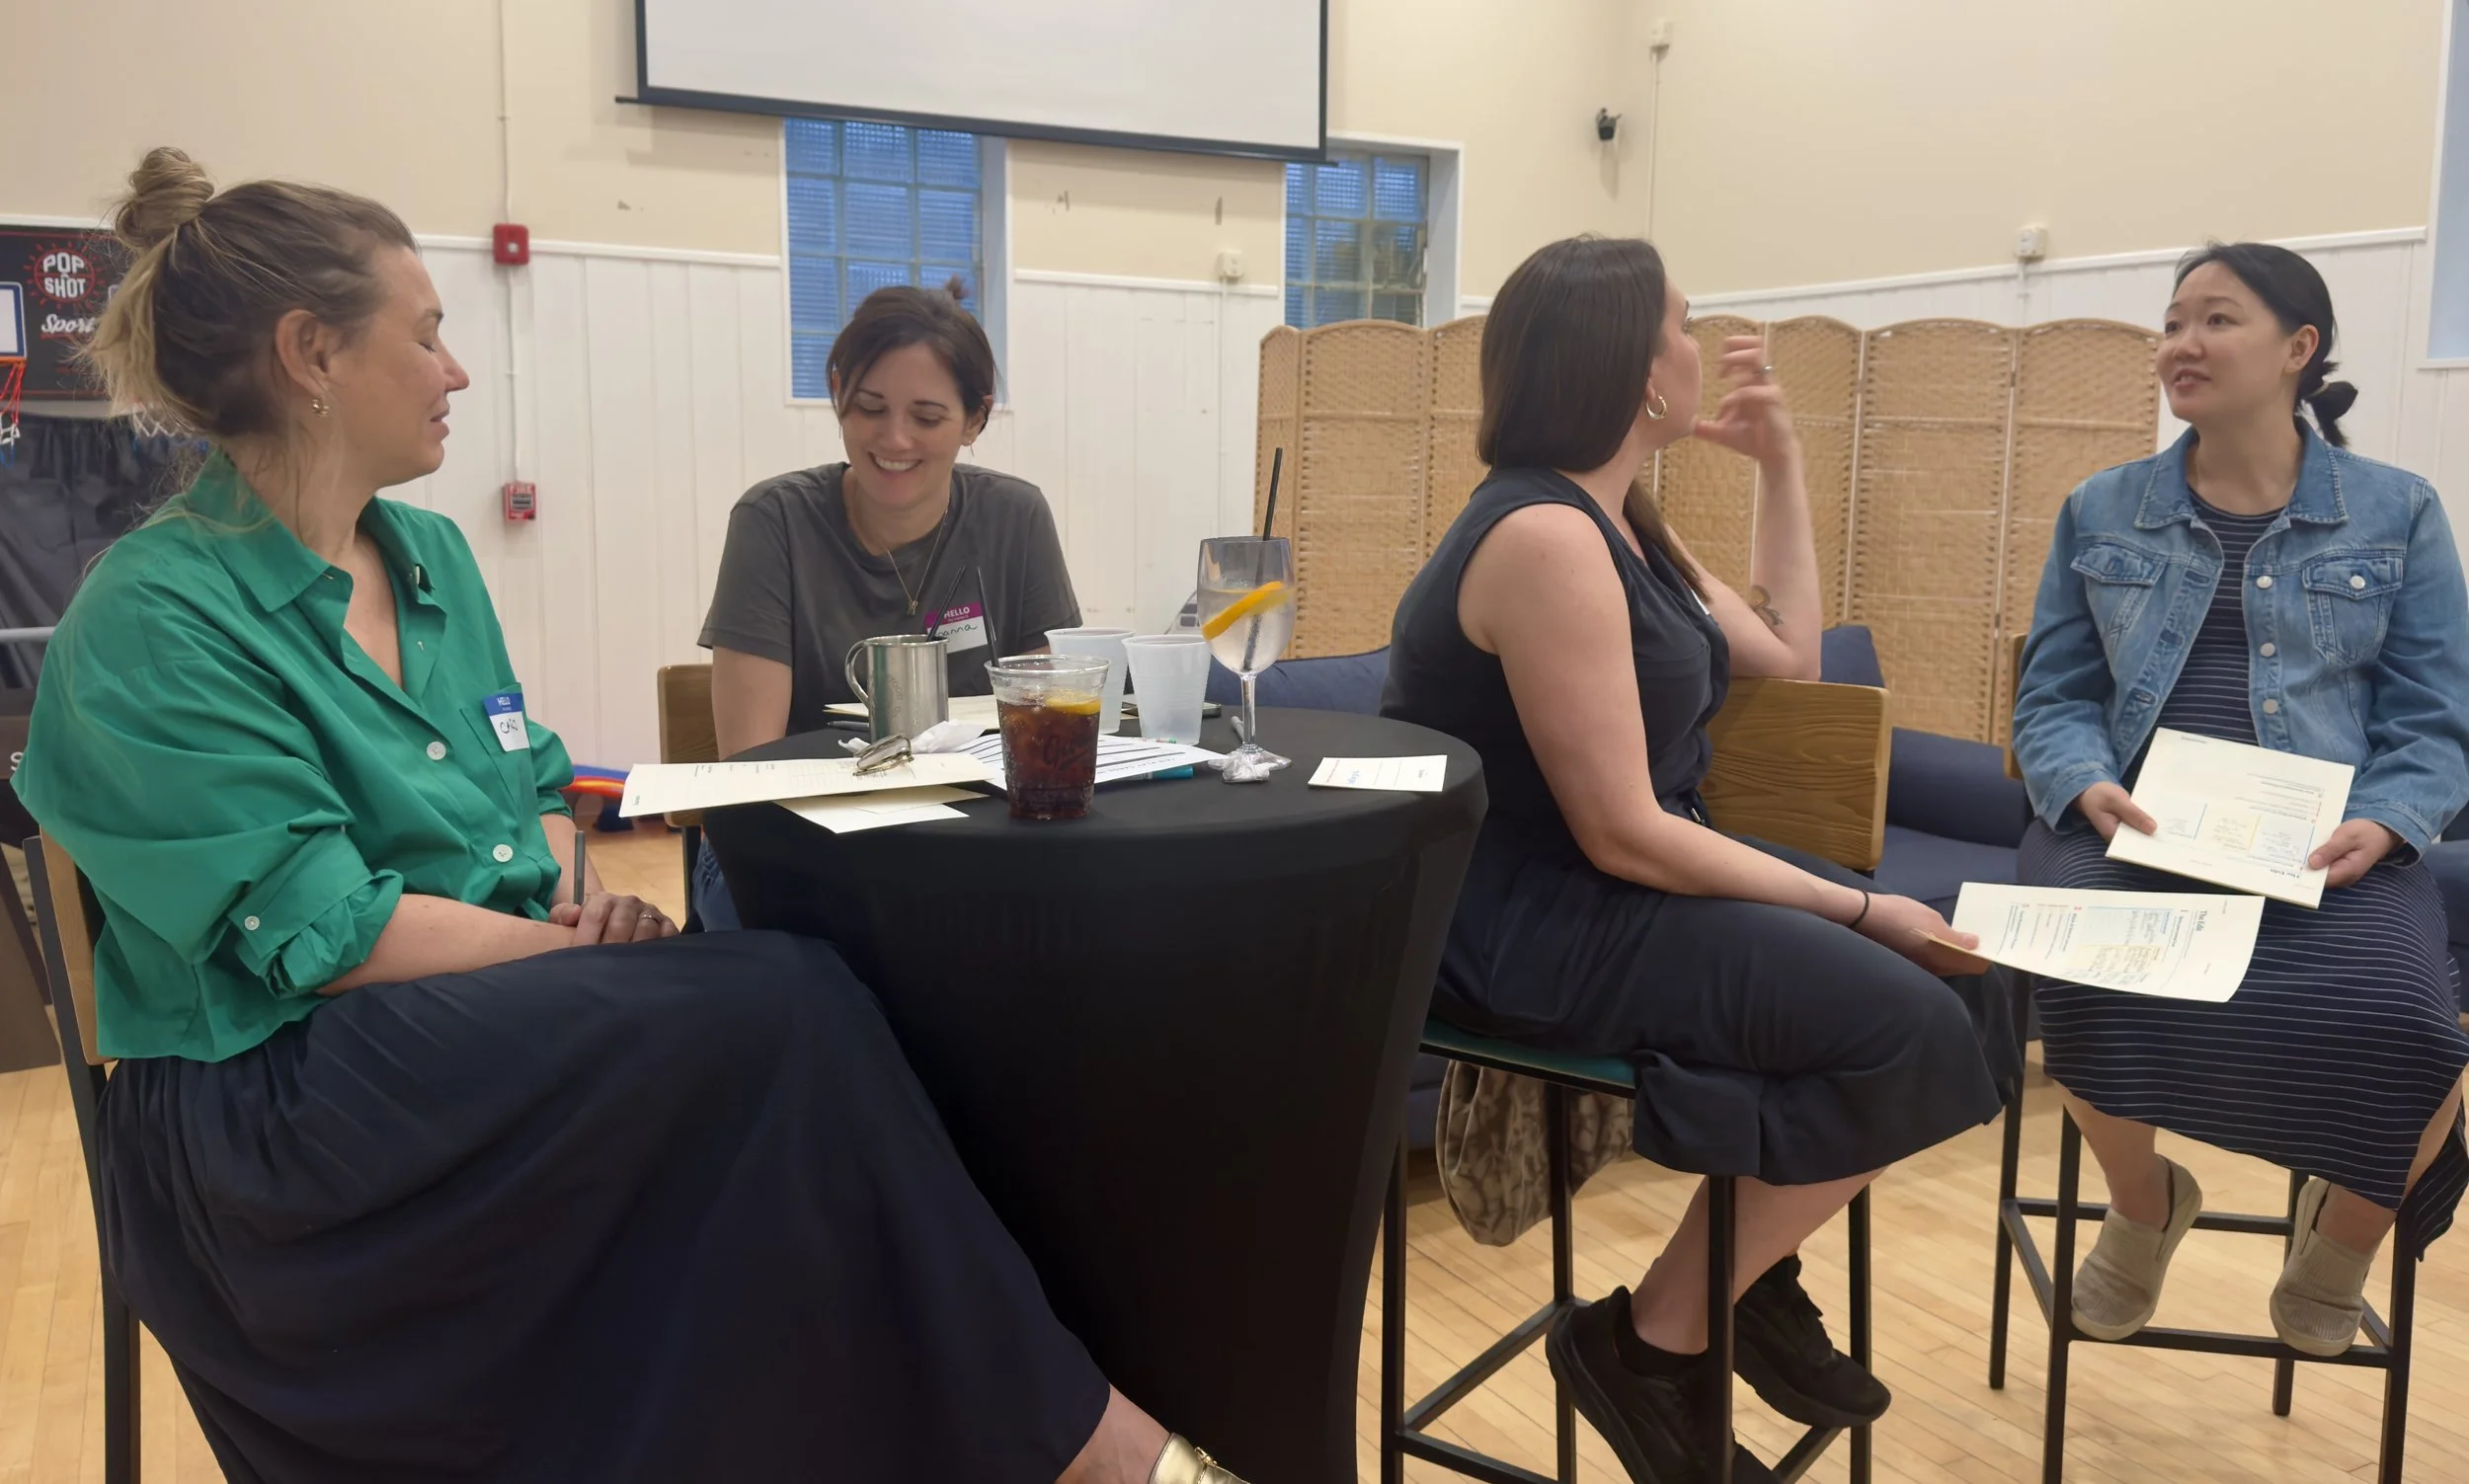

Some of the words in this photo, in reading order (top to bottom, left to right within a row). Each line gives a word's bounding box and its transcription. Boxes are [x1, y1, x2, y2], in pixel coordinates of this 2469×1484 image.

[43, 252, 85, 273] POP
[44, 277, 86, 298] SHOT
[944, 606, 970, 619] HELLO
